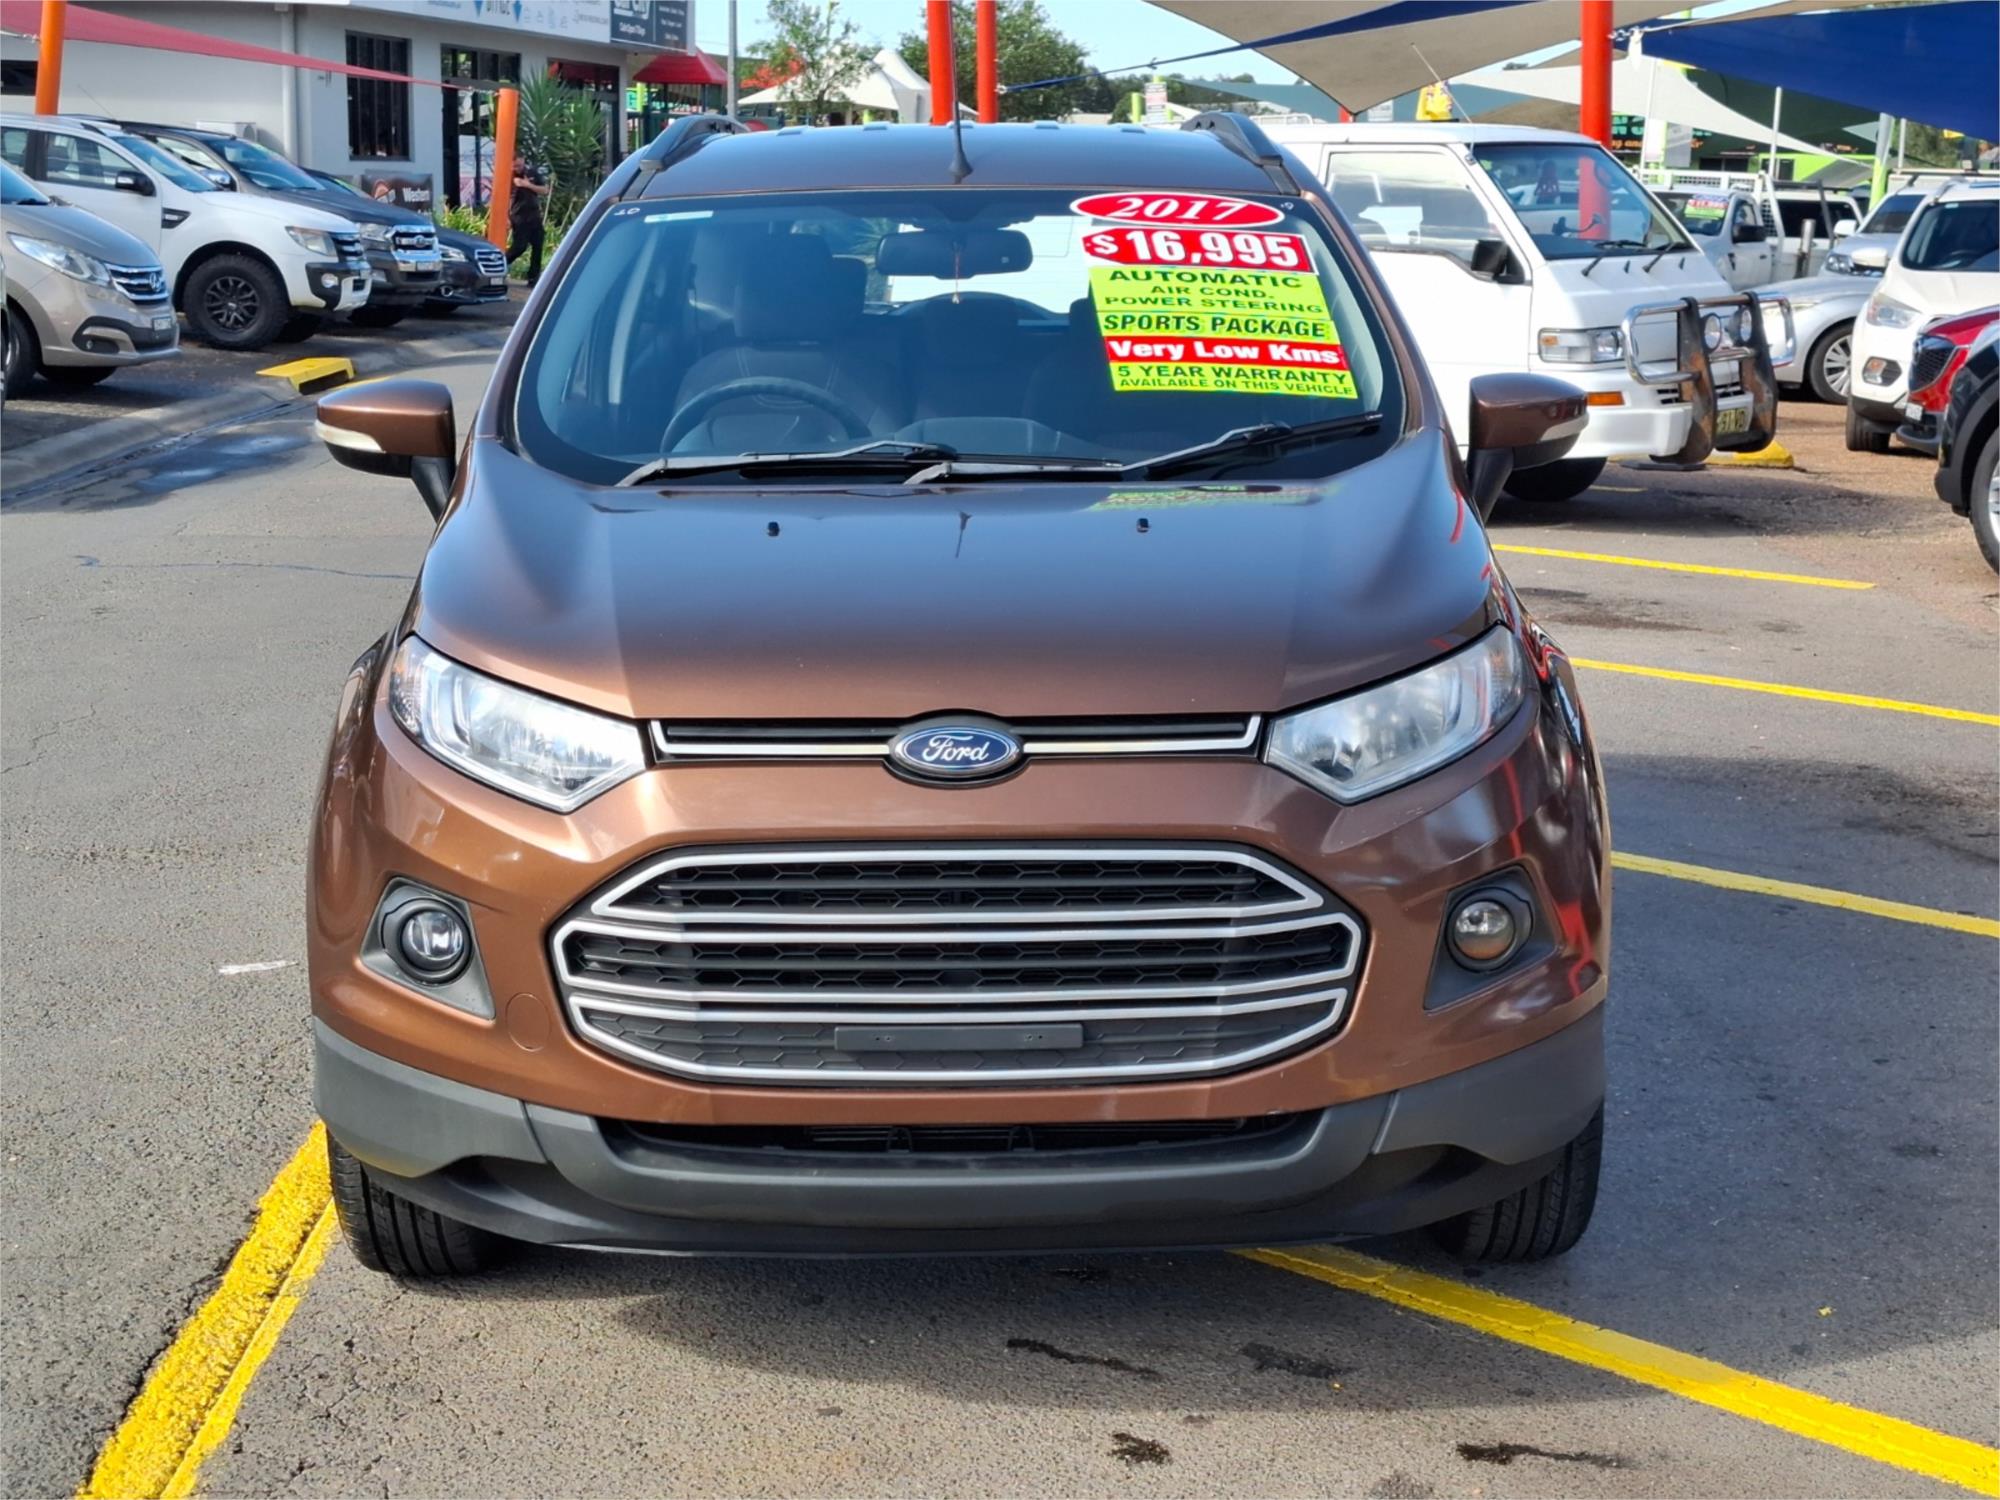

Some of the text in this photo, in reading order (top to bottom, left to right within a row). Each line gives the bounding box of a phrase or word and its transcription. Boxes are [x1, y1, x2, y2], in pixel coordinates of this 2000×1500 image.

[1106, 197, 1250, 221] 2017
[1091, 230, 1299, 267] $ 16,995
[1109, 269, 1302, 288] AUTOMATIC
[1151, 285, 1275, 298] AIR COND.
[1104, 296, 1323, 314] POWER STEERING
[1103, 314, 1325, 337] SPORTS PACKAGE
[1108, 340, 1341, 364] Very Low Kms
[1118, 365, 1347, 382] 5 YEAR WARRANTY
[1120, 378, 1353, 396] AVAILABLE ON THIS VEHICLE
[921, 734, 991, 762] Ford
